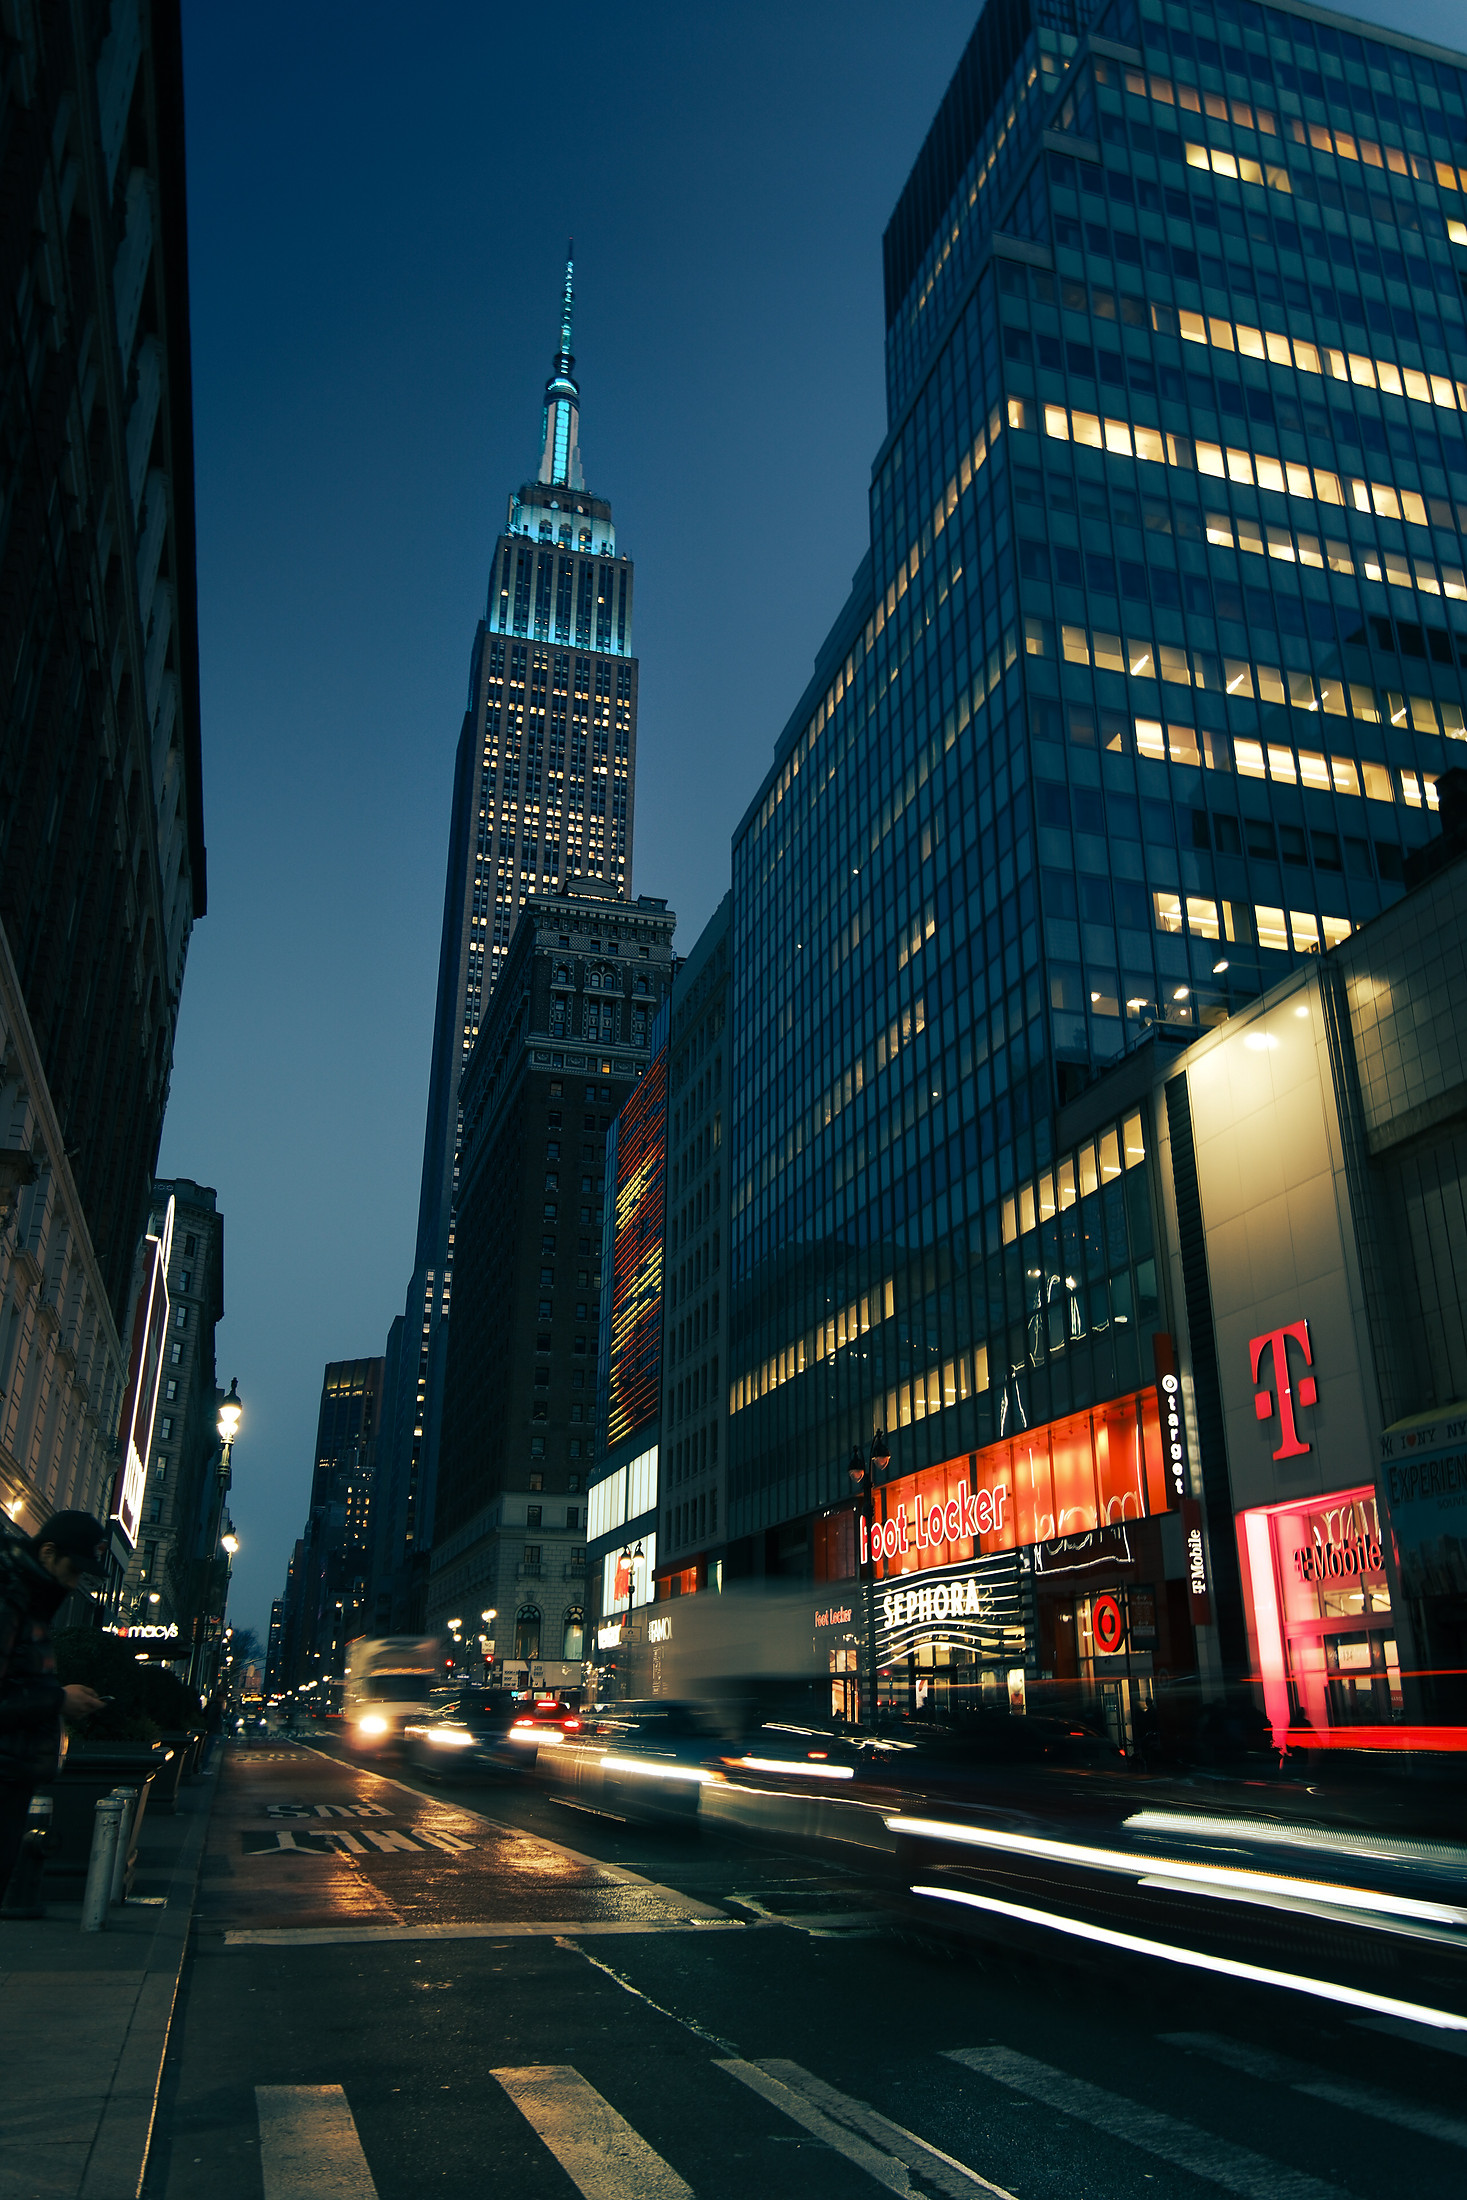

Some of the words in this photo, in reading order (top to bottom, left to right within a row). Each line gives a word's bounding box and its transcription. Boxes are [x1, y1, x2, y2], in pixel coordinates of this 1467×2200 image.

[1167, 1394, 1184, 1495] target
[914, 1480, 1006, 1550] Locker
[814, 1610, 829, 1628] Foot
[829, 1606, 852, 1625] Locker
[883, 1579, 981, 1629] SEPHORA
[128, 1622, 179, 1641] macy's
[266, 1803, 396, 1820] BUS
[245, 1828, 477, 1856] ONLY
